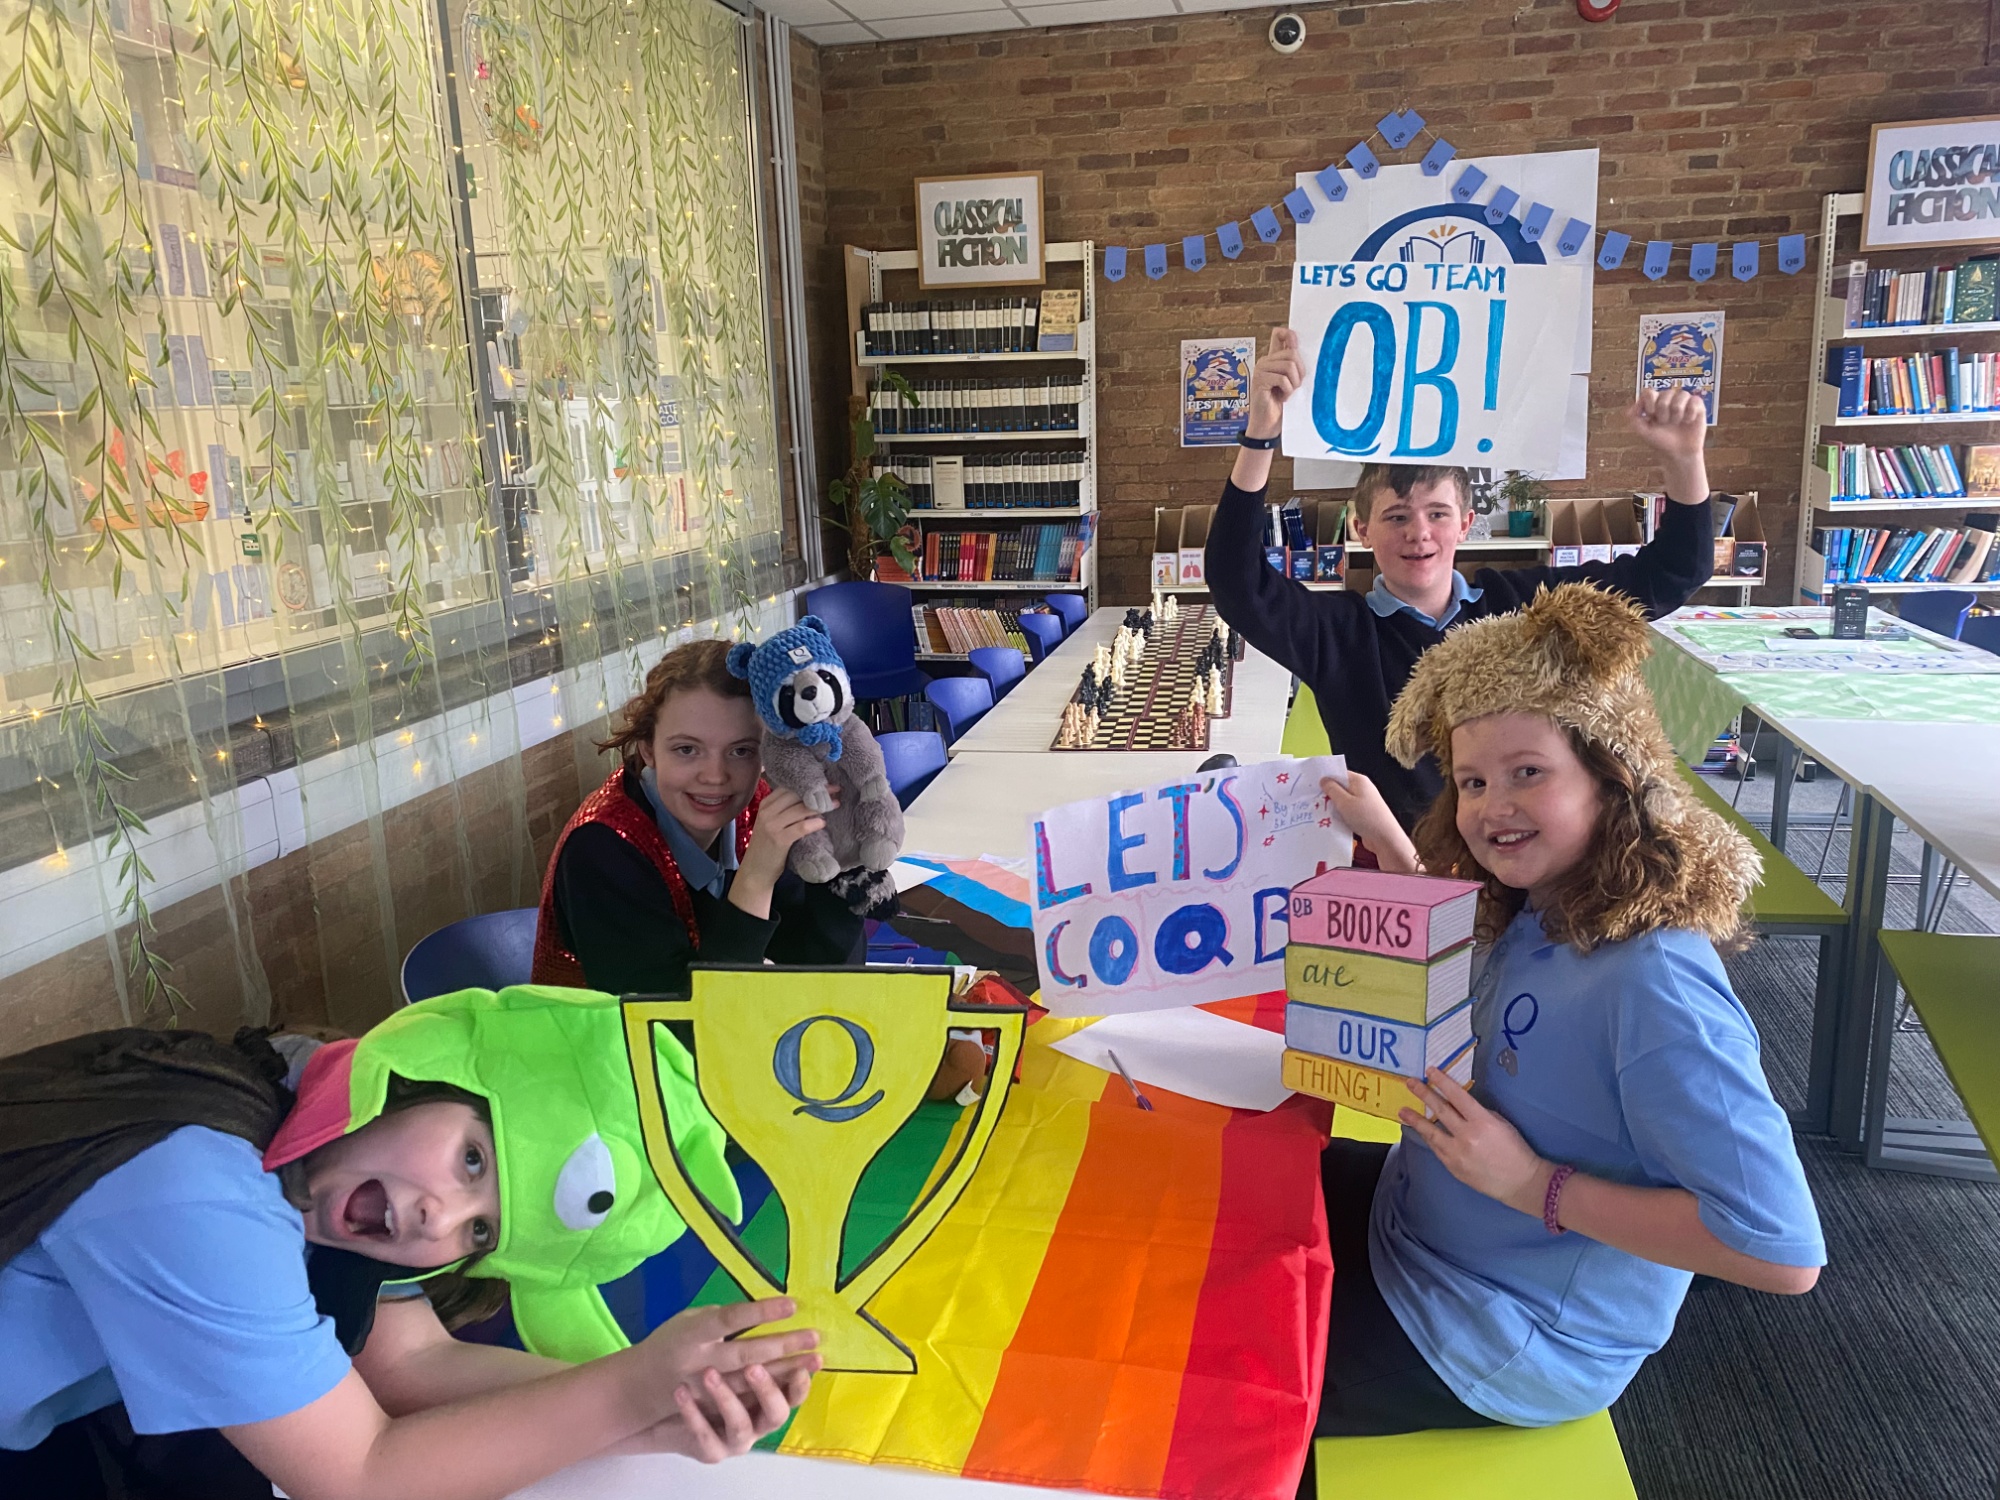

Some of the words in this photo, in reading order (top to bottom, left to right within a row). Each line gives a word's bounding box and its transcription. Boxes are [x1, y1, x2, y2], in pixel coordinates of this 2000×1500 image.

[1394, 132, 1406, 142] QB
[1363, 162, 1374, 174] QB
[1428, 160, 1439, 170] QB
[1331, 186, 1342, 196] QB
[1458, 187, 1470, 197] QB
[934, 198, 1027, 236] CLASSICAL
[1299, 209, 1310, 218] QB
[1492, 208, 1502, 218] QB
[1266, 228, 1276, 238] QB
[1528, 226, 1539, 234] QB
[1228, 244, 1239, 252] QB
[1562, 242, 1574, 251] QB
[938, 236, 1028, 268] FICTION
[1191, 258, 1202, 266] QB
[1604, 256, 1616, 264] QB
[1786, 258, 1799, 266] QB
[1152, 266, 1163, 274] QB
[1650, 266, 1663, 274] QB
[1739, 265, 1752, 273] QB
[1300, 264, 1356, 287] LET'S
[1366, 262, 1408, 292] GO
[1424, 263, 1506, 294] TEAM
[1312, 299, 1506, 458] QB!
[1644, 377, 1712, 388] FESTIVAL
[1187, 400, 1247, 410] FESTIVAL
[794, 648, 806, 656] Q
[1034, 776, 1248, 909] LET'S
[1292, 897, 1312, 918] QB
[1326, 901, 1412, 948] BOOKS
[1154, 887, 1290, 977] QB
[1302, 960, 1354, 988] are
[1338, 1030, 1400, 1068] OUR
[773, 1015, 886, 1122] Q
[1294, 1058, 1382, 1107] THING!
